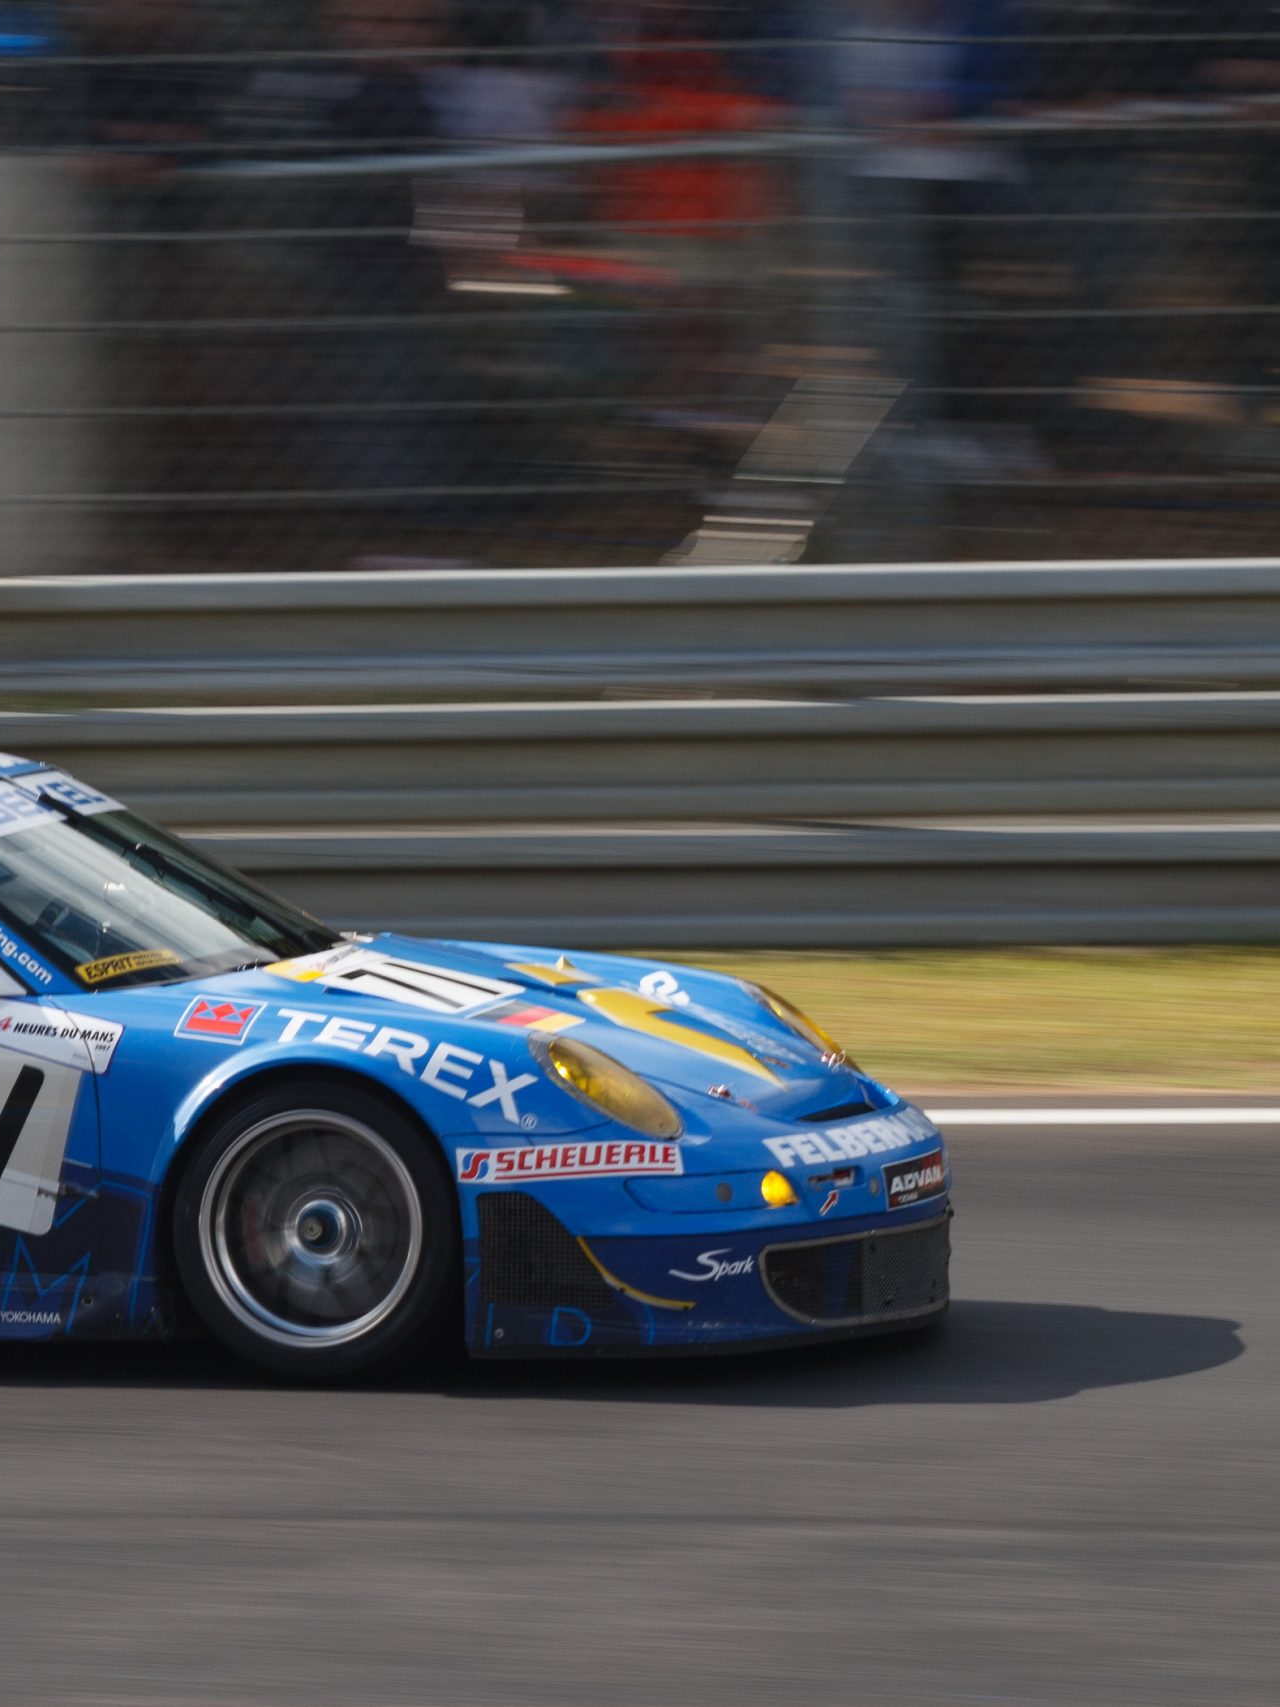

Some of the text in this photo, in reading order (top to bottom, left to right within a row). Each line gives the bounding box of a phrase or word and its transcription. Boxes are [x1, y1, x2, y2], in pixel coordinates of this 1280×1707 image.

[85, 956, 133, 980] ESPRIT
[339, 962, 502, 1009] 71
[13, 1022, 58, 1038] HEURES
[60, 1027, 79, 1039] DU
[80, 1029, 115, 1043] MANS
[275, 1007, 538, 1126] TEREX
[495, 1143, 677, 1173] SCHEUERLE
[890, 1165, 944, 1195] ADVAN
[669, 1248, 754, 1283] Spark
[0, 1309, 62, 1325] YOKOHAMA
